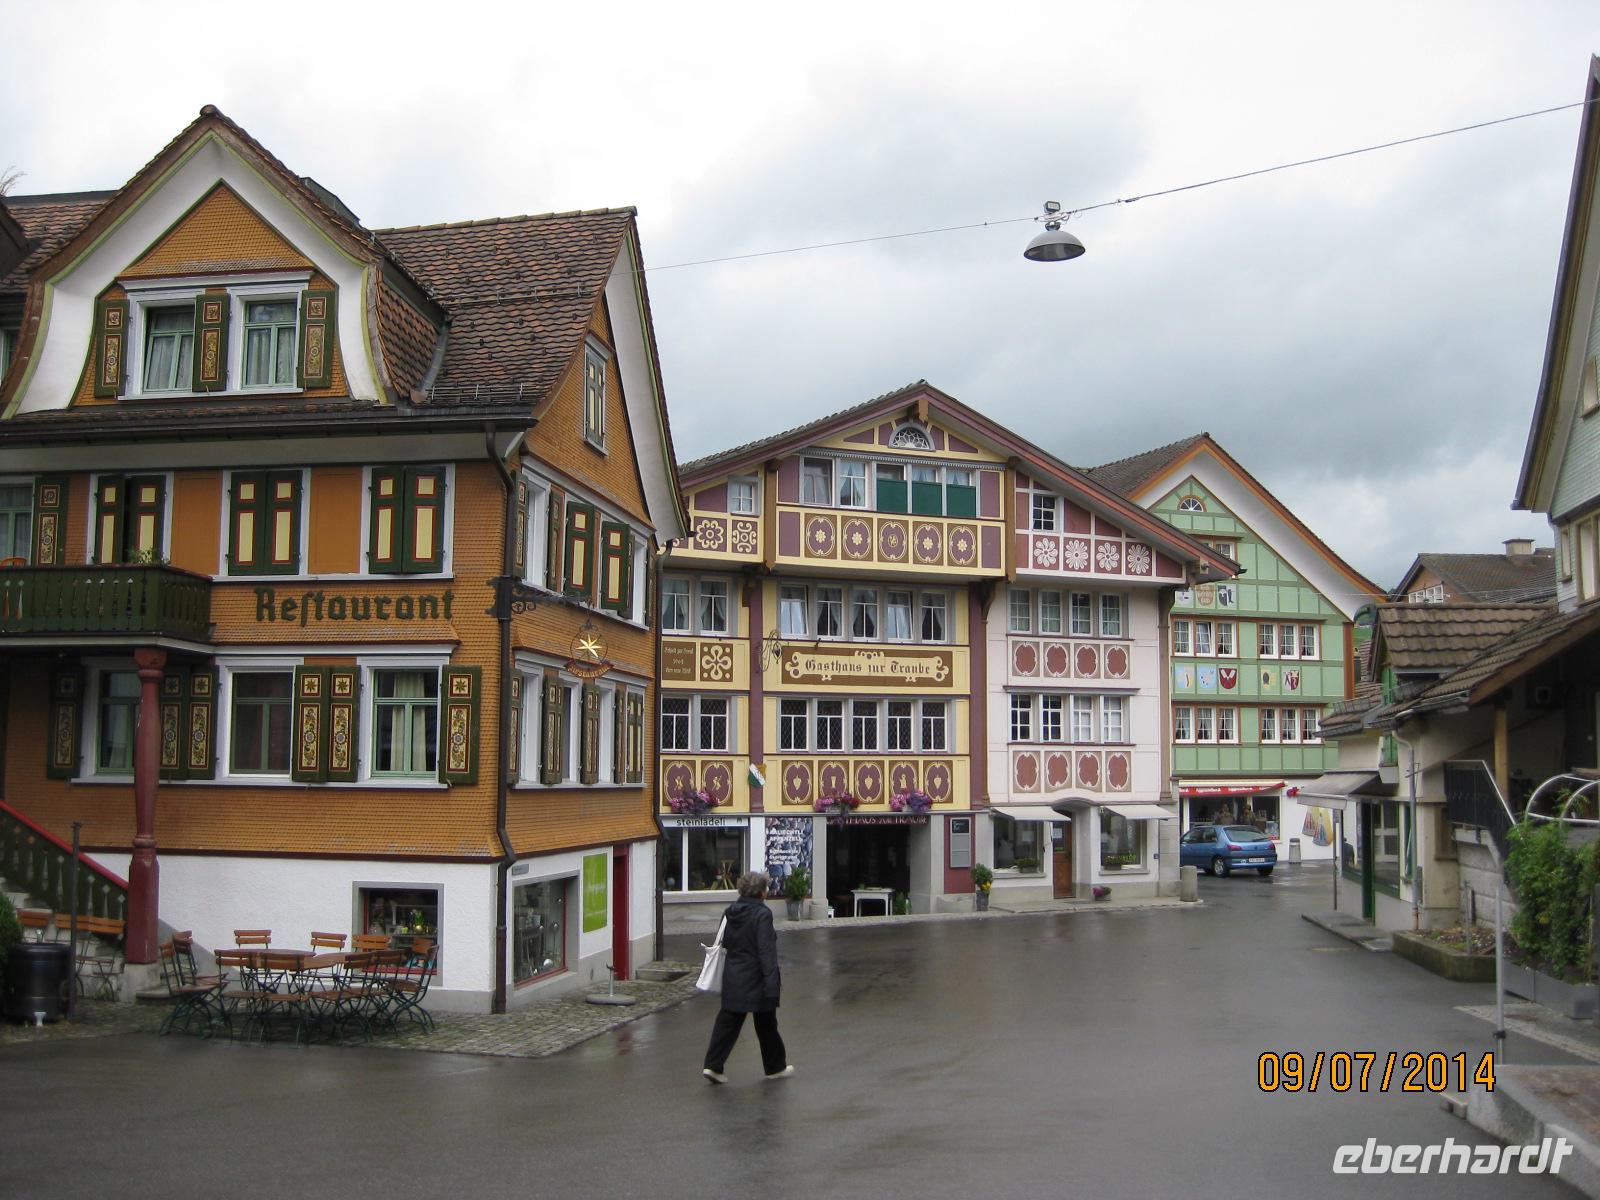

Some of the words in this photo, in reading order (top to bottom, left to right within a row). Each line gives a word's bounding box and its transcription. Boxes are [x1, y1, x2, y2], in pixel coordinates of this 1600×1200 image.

[254, 587, 454, 628] Restaurant
[805, 659, 862, 673] Gasthaus
[868, 663, 886, 674] zur
[890, 660, 930, 675] Traube
